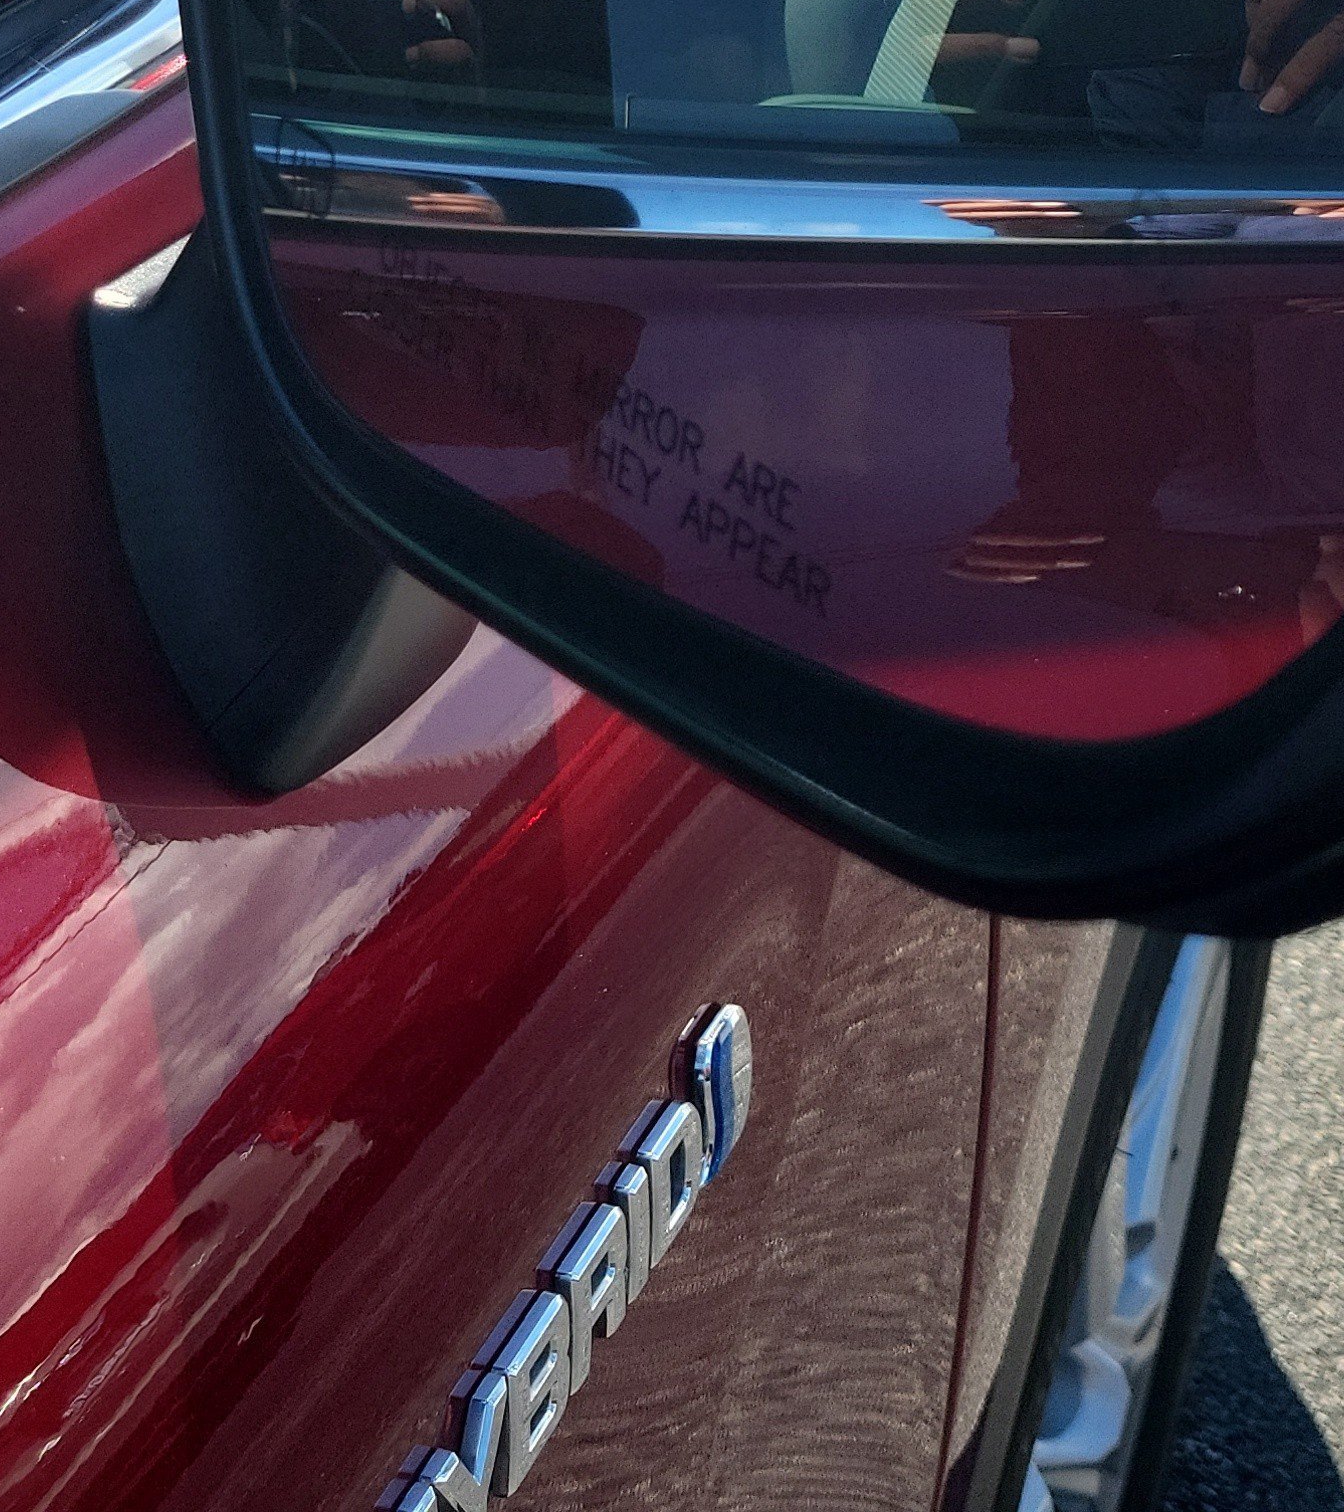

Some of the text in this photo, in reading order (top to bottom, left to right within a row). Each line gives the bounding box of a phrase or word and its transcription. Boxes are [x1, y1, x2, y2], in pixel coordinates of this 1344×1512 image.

[677, 490, 833, 620] APPEAR
[723, 450, 802, 533] ARE
[396, 1099, 704, 1512] YBRID
